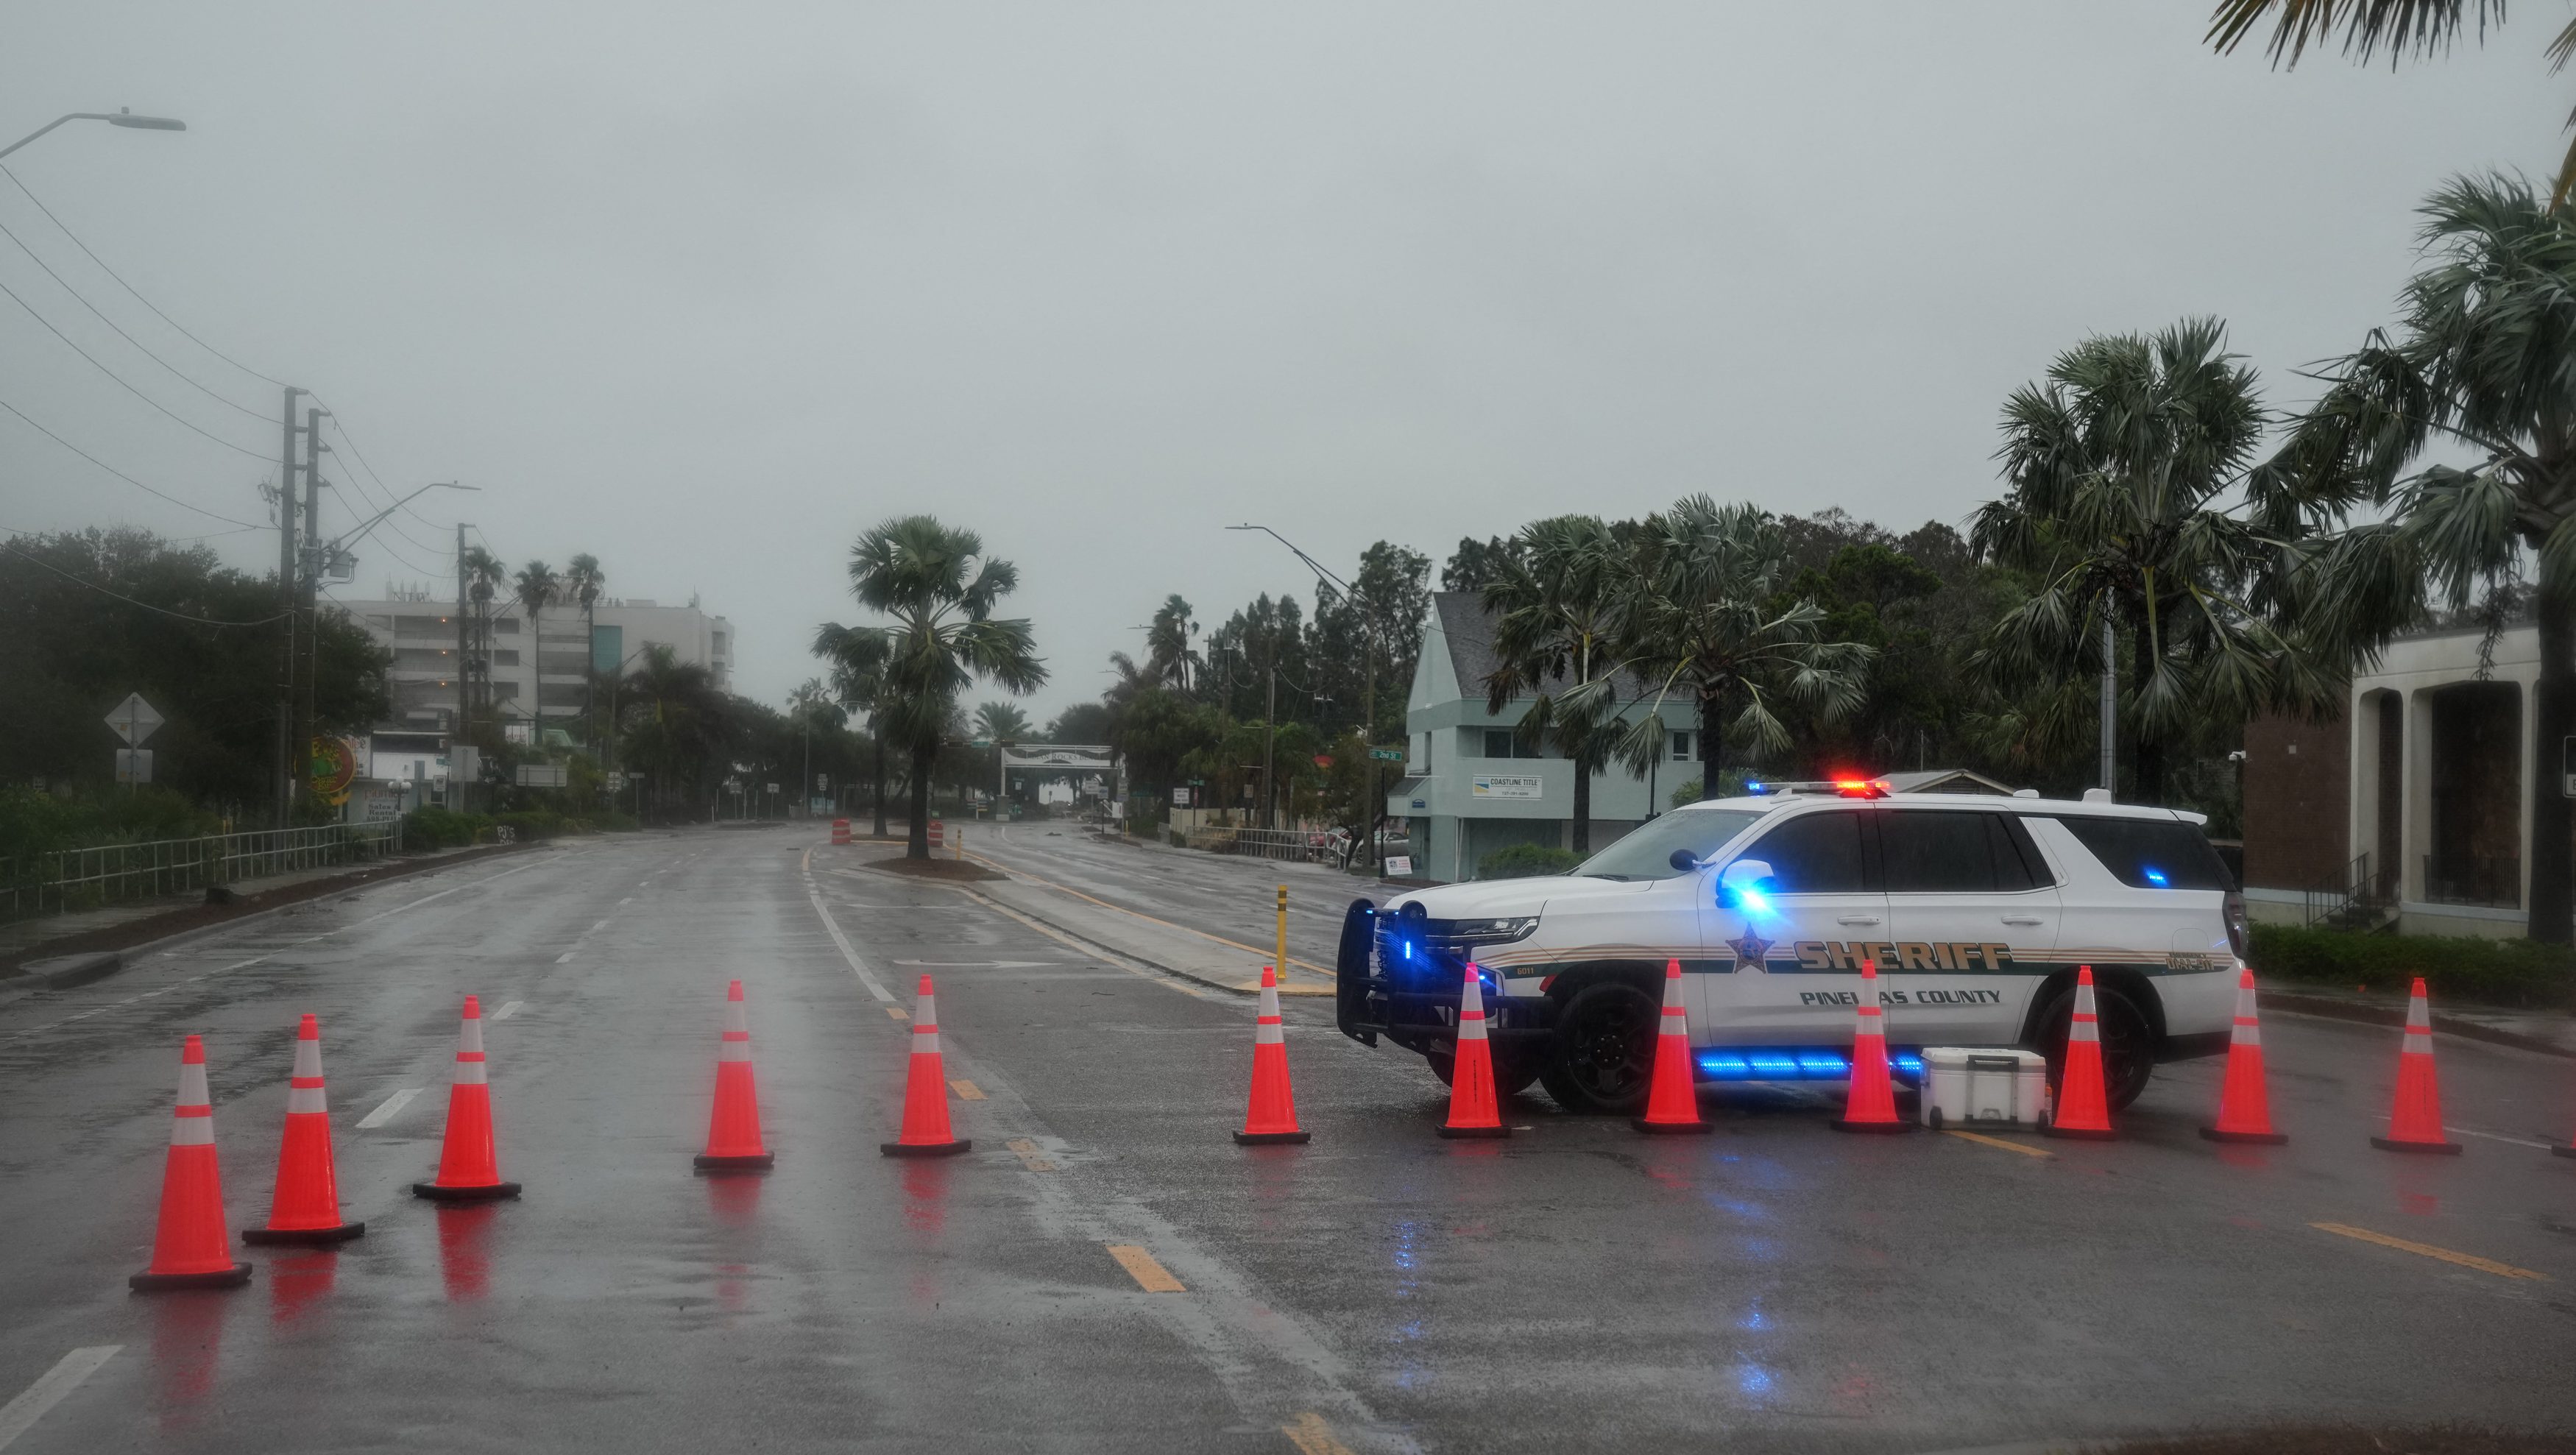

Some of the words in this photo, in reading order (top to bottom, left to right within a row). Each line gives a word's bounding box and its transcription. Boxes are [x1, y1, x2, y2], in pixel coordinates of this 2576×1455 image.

[1052, 753, 1078, 761] ROCKS
[1490, 778, 1522, 786] COASTLINE
[1794, 941, 2013, 971] SHERIFF
[1518, 967, 1535, 975] 6011
[1800, 991, 1908, 1005] PINELAS
[1916, 991, 2000, 1004] COUNTY
